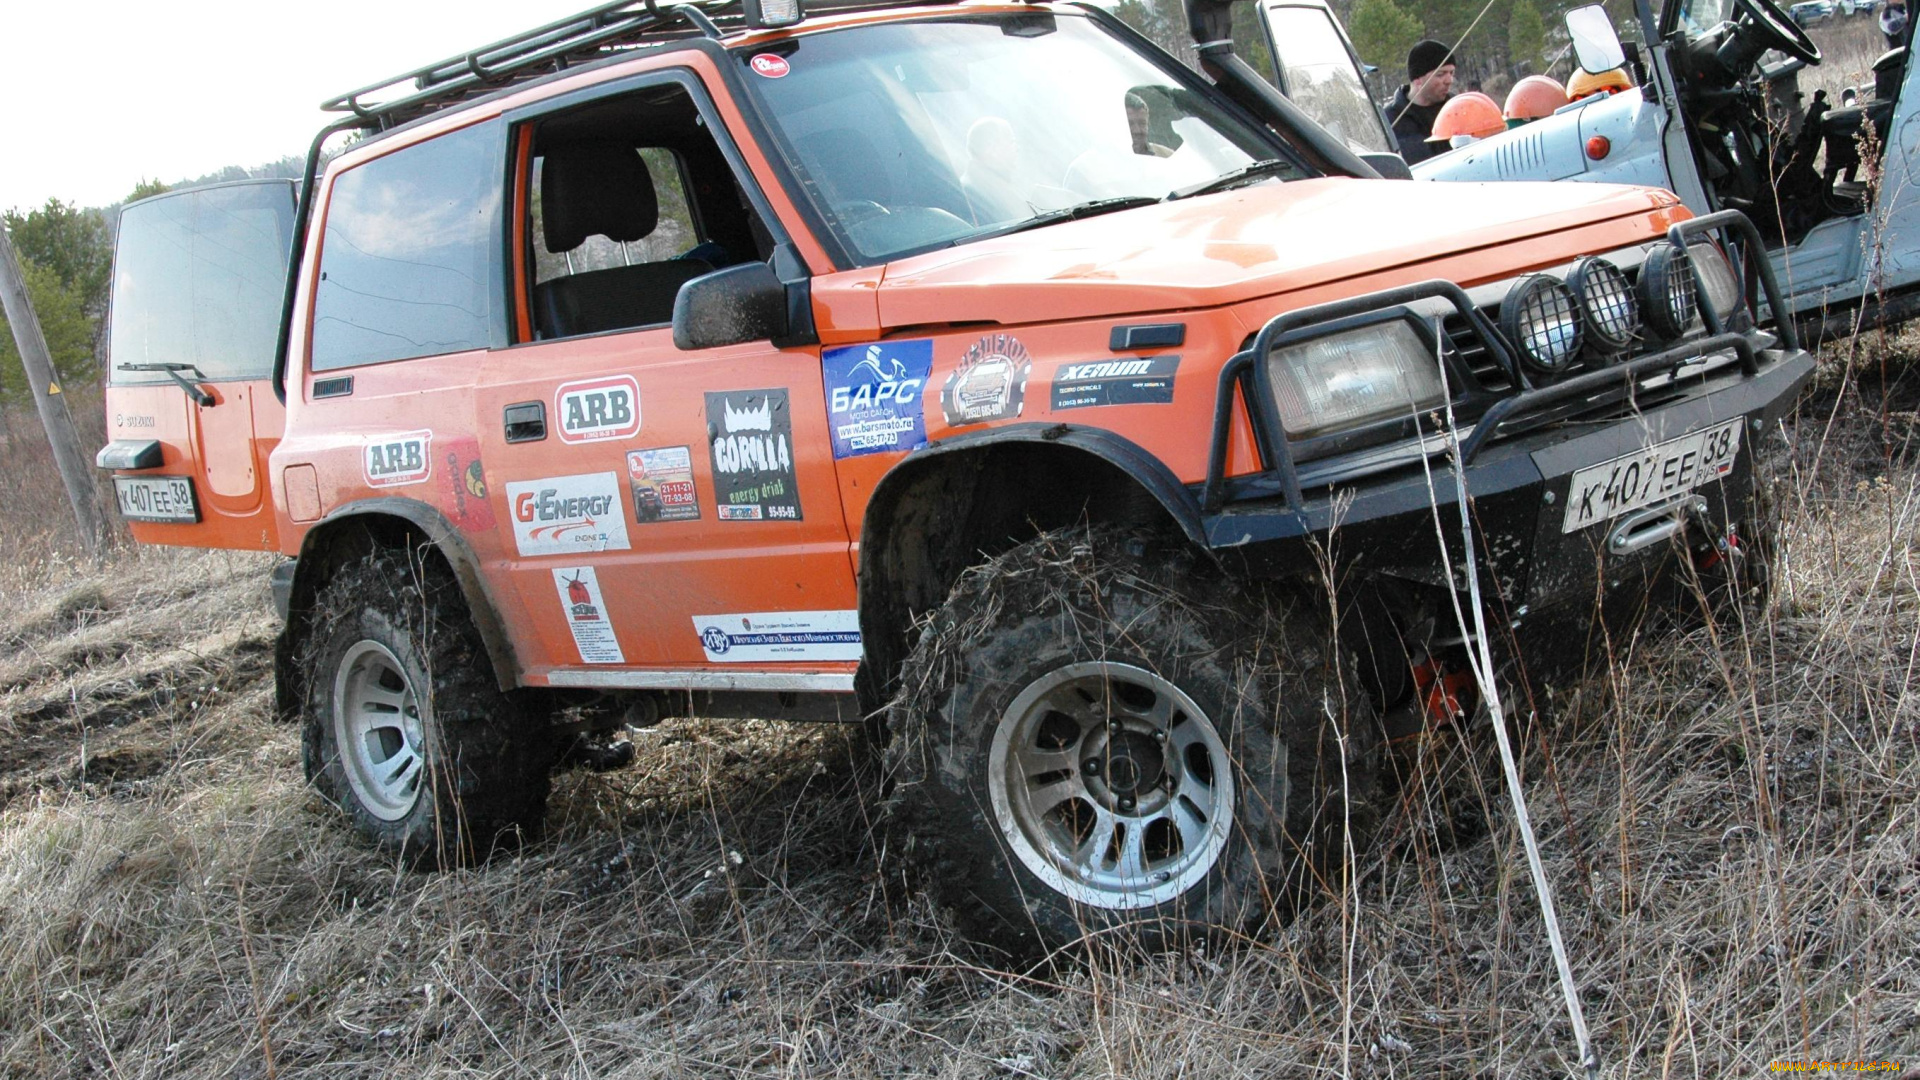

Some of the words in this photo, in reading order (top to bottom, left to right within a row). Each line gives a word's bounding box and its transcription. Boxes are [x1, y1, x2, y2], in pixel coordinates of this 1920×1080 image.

[832, 378, 921, 413] БАРС
[126, 416, 155, 427] SUZUKI
[566, 390, 631, 429] ARB
[840, 420, 912, 436] www.barsmoto.ru
[370, 441, 422, 475] ARB
[714, 433, 790, 473] GORILLA
[1704, 428, 1731, 464] 38
[1697, 464, 1716, 479] RUS
[171, 482, 188, 504] 38
[661, 483, 691, 494] 21-11-21
[729, 487, 760, 504] energy
[762, 479, 785, 499] drink
